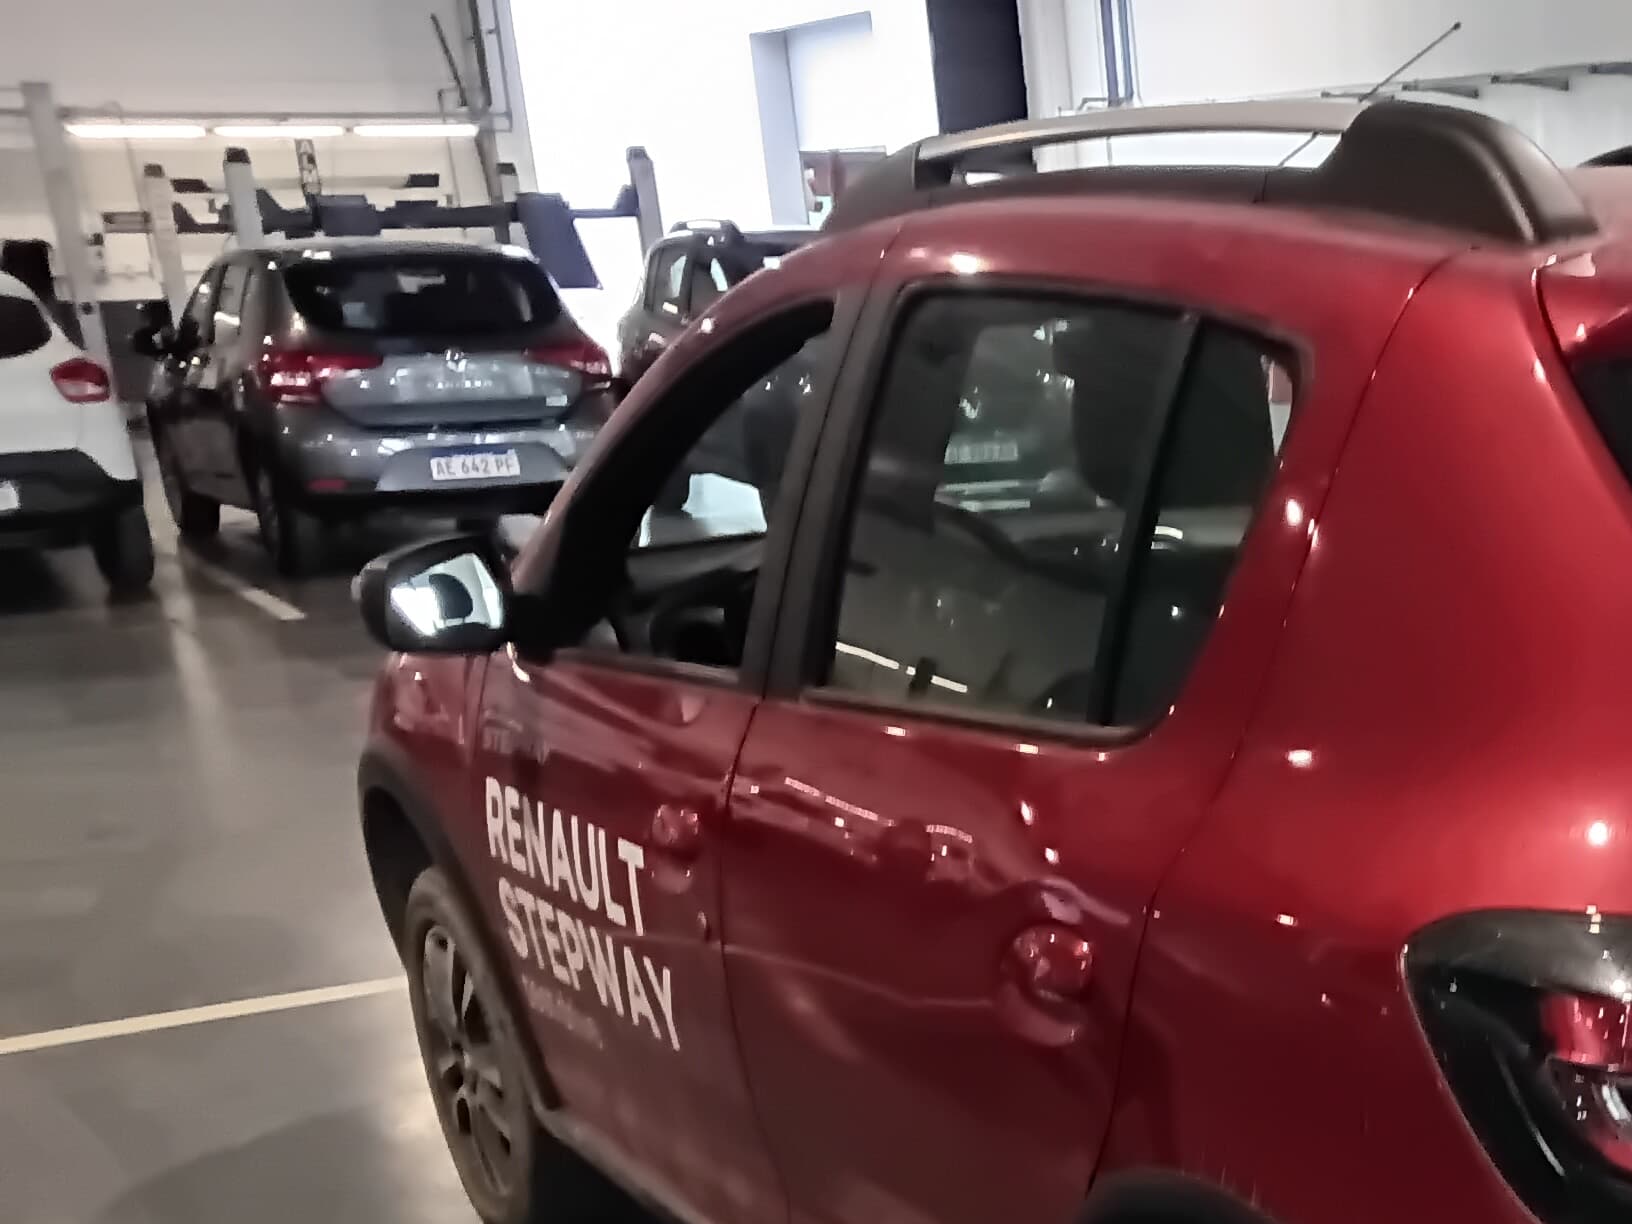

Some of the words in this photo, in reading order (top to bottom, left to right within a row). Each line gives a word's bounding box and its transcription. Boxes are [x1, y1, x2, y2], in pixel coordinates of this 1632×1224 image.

[460, 458, 491, 475] 642
[486, 776, 644, 937] RENAULT
[498, 876, 681, 1051] STEPWAY
